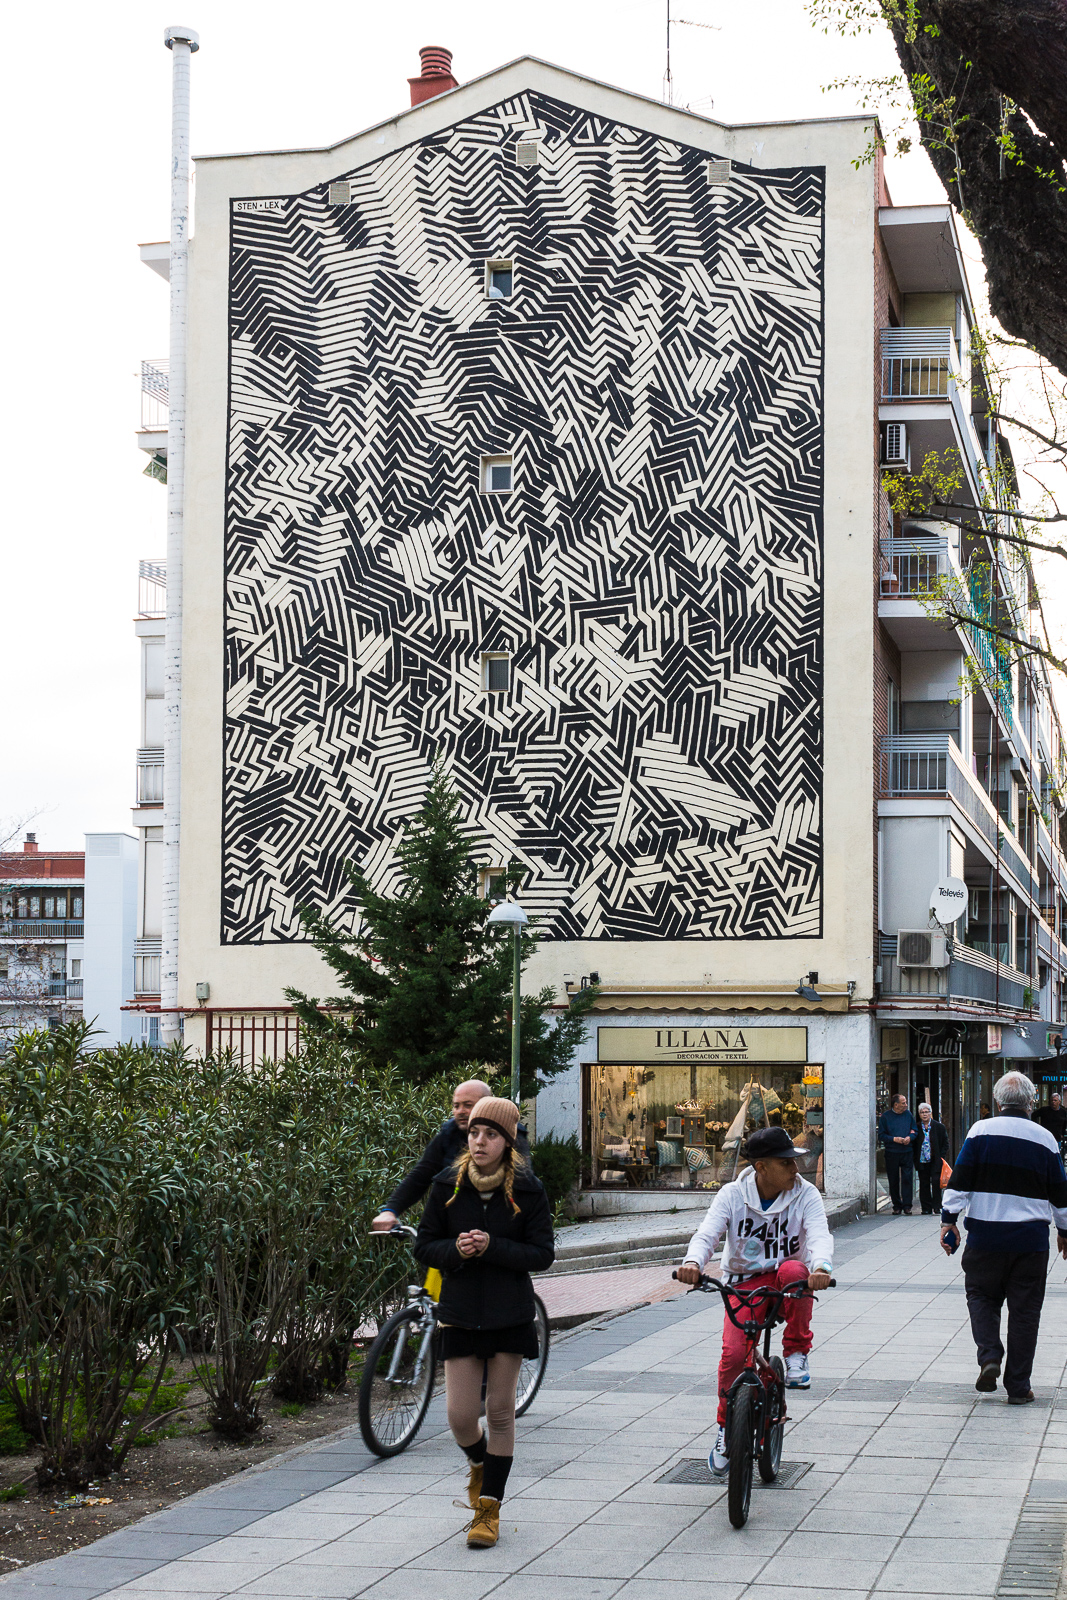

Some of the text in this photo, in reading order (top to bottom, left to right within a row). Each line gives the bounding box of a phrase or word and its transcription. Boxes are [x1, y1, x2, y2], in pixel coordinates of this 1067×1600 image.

[237, 202, 258, 210] STEN
[264, 201, 280, 209] LEX
[938, 887, 965, 899] Televés
[654, 1030, 749, 1048] ILLANA
[764, 1235, 801, 1260] THE
